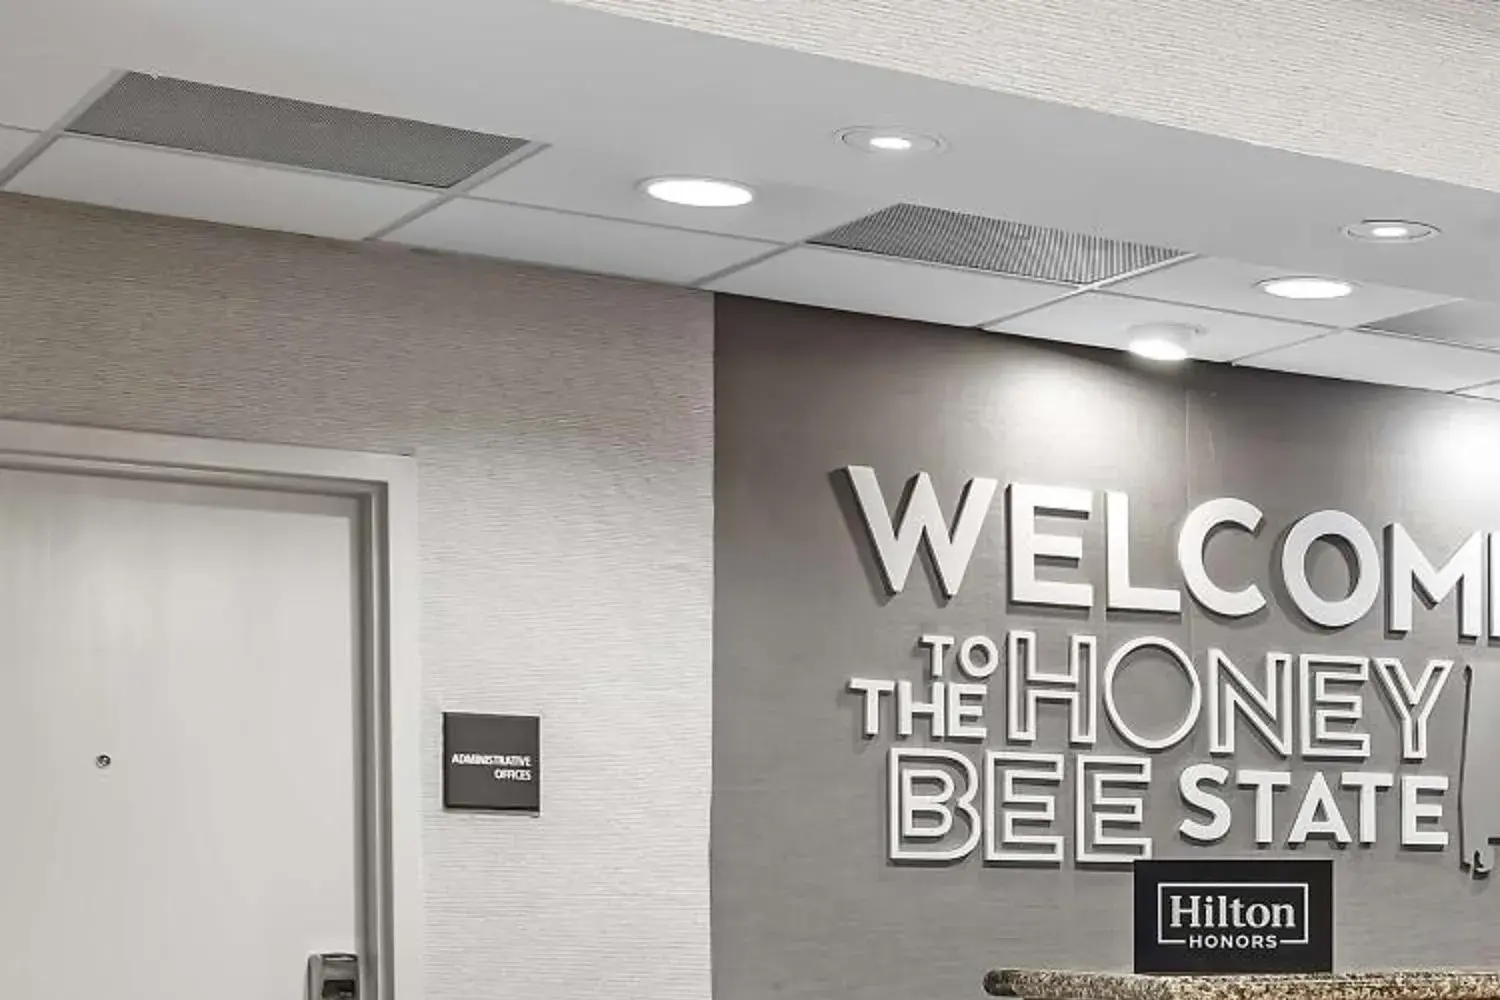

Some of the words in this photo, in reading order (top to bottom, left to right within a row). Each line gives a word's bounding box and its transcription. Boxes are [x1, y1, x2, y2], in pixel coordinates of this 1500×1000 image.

[920, 633, 998, 679] TO
[849, 677, 988, 739] THE
[1006, 629, 1455, 762] HONEY
[493, 768, 532, 781] OFFICES
[888, 746, 1153, 864] BEE
[1178, 763, 1450, 848] STATE
[1169, 895, 1296, 928] Hilton
[1189, 934, 1278, 949] HONORS
